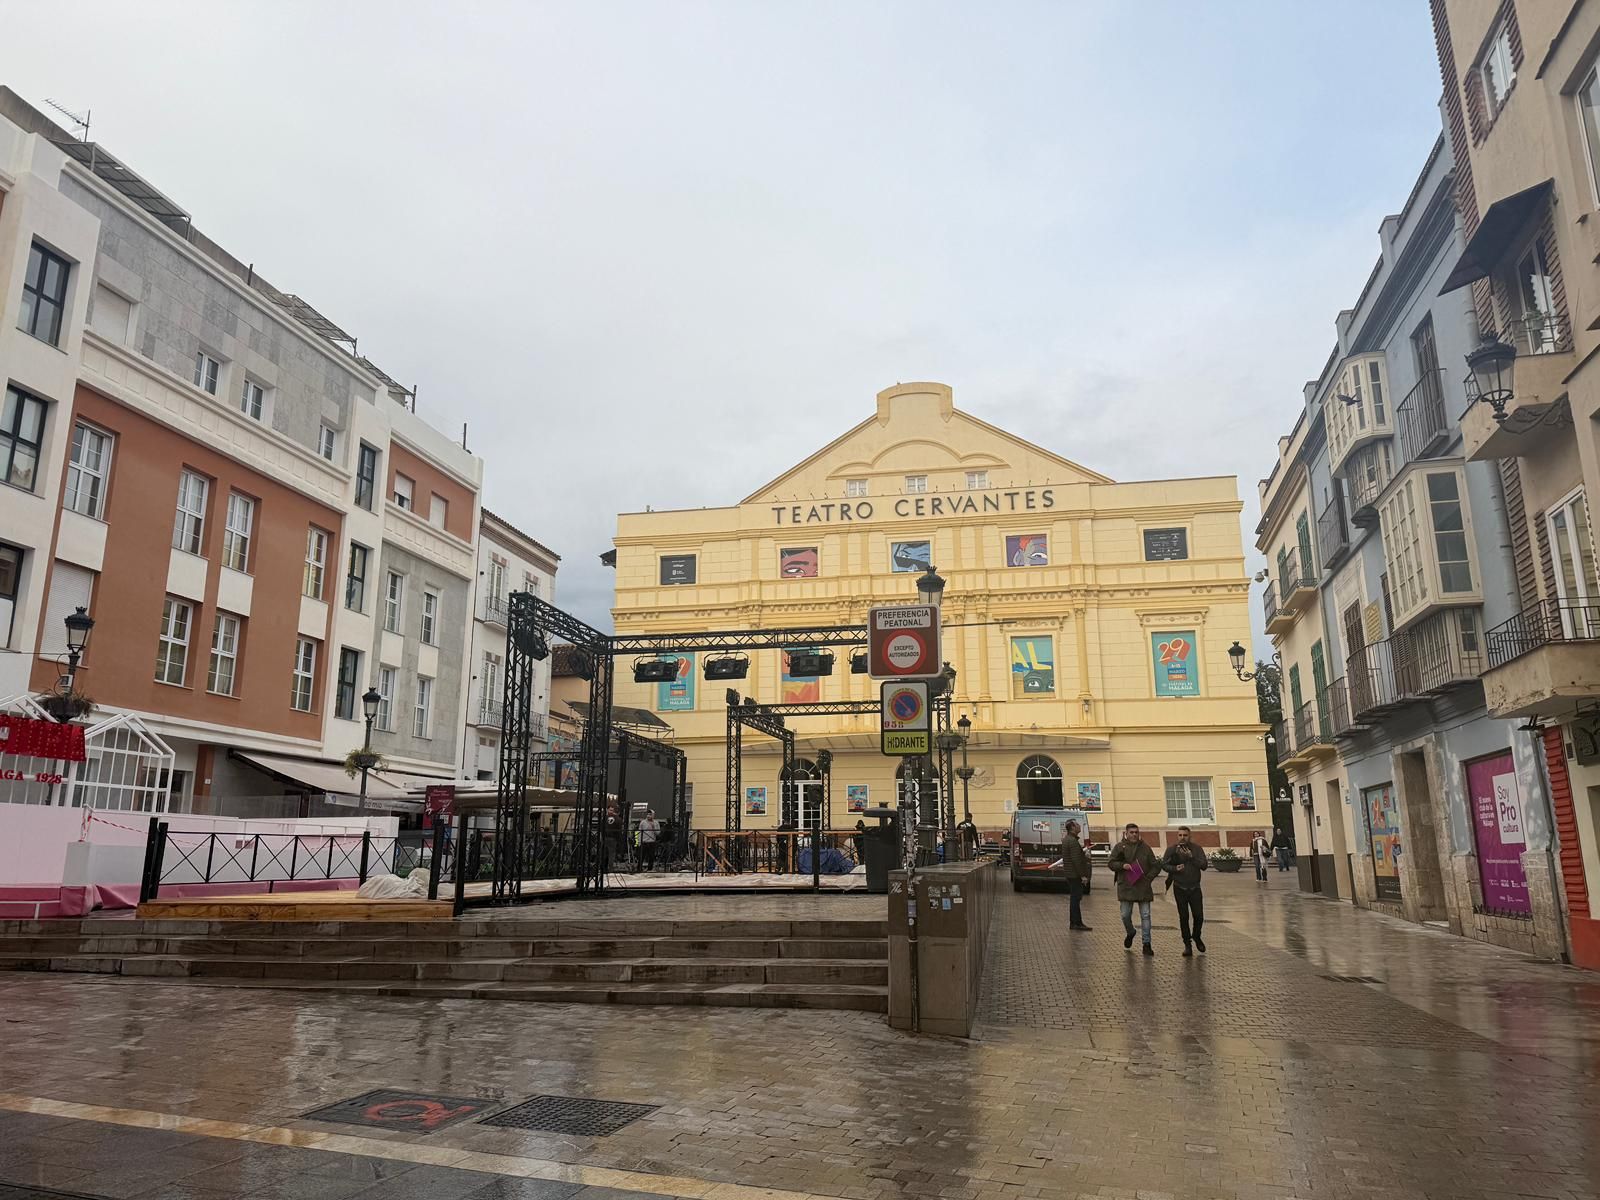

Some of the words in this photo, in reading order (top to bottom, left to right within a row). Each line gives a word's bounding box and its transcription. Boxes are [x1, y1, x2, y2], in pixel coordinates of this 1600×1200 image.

[771, 501, 873, 524] TEATRO
[894, 490, 1054, 517] CERVANTES
[877, 610, 929, 619] PREFERENCIA
[884, 619, 923, 627] PEATONAL
[1157, 637, 1184, 662] 29
[887, 736, 925, 749] HIDRANTE
[34, 772, 62, 784] 1928
[1497, 785, 1510, 802] Soy
[1499, 802, 1517, 822] Pro
[1503, 823, 1519, 833] cultura
